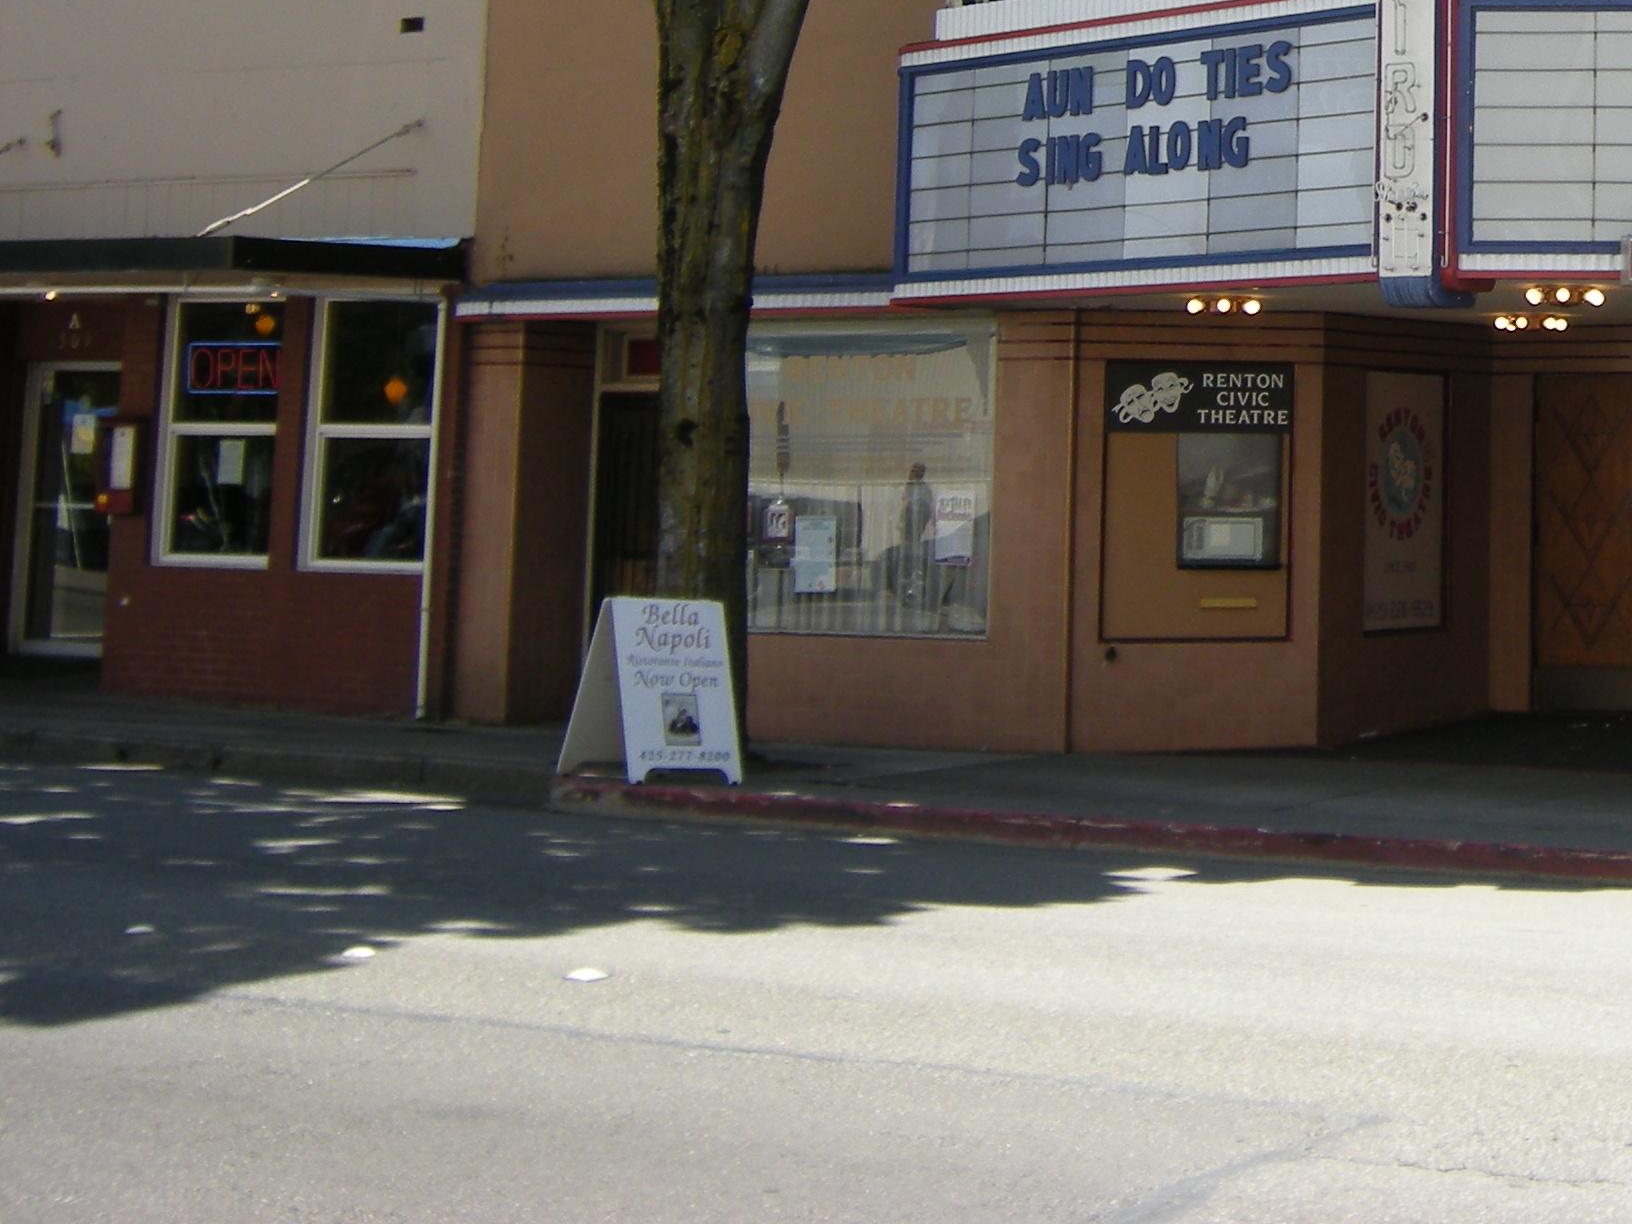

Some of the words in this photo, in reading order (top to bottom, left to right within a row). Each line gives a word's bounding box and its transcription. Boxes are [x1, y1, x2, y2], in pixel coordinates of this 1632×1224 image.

[1021, 65, 1094, 122] AUN
[1125, 55, 1177, 111] DO
[1200, 39, 1293, 102] TIES
[1016, 131, 1103, 187] SING
[1123, 115, 1250, 176] ALONG
[190, 348, 281, 390] OPEN
[787, 355, 914, 382] RENTON
[1202, 373, 1285, 389] RENTON
[830, 396, 973, 427] THEATRE
[1216, 391, 1270, 407] CIVIC
[1197, 409, 1289, 425] THEATRE
[641, 603, 700, 627] Bella
[634, 627, 712, 655] Napoli
[633, 669, 675, 688] Now
[678, 671, 721, 693] Open
